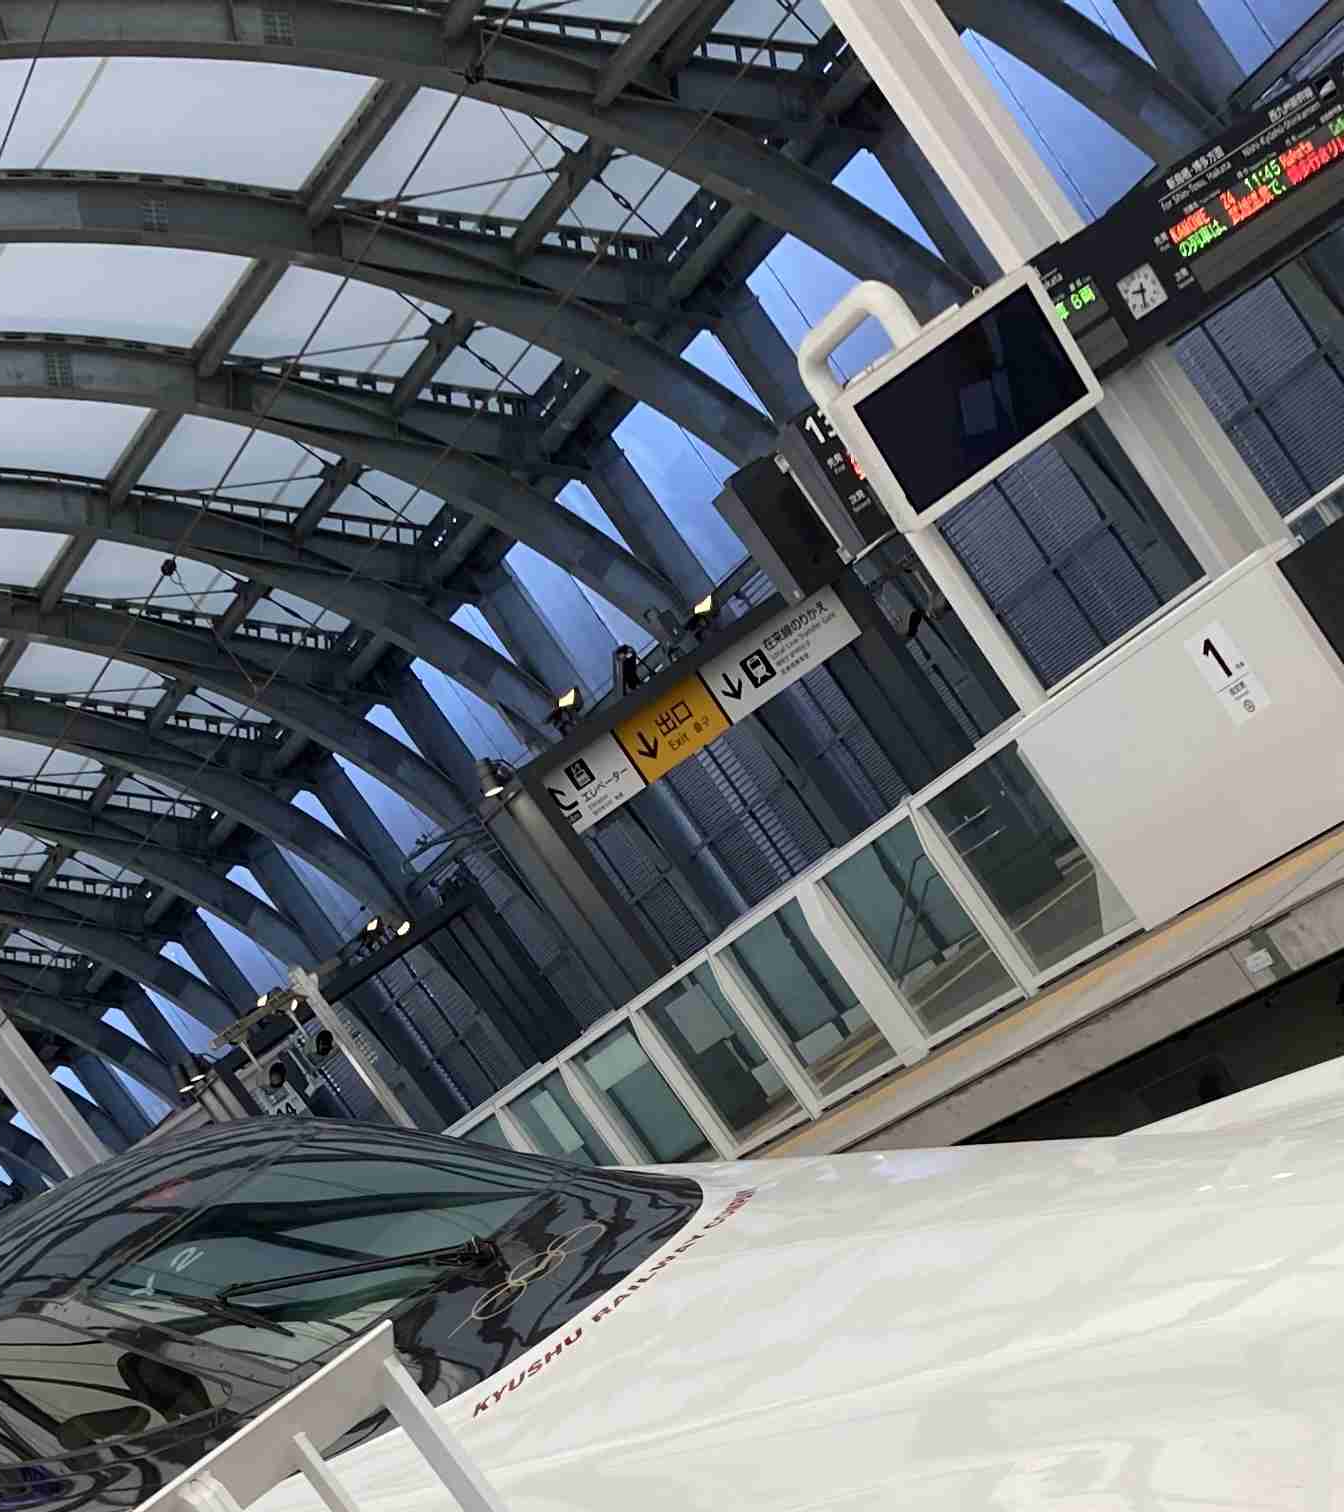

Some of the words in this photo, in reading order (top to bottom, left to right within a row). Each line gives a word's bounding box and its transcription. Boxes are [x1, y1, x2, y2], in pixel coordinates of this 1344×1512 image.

[1245, 159, 1281, 190] 11:45
[1203, 638, 1233, 678] 1
[655, 701, 693, 737] 出口
[668, 732, 689, 751] Exit
[472, 1327, 582, 1418] KYUSHU
